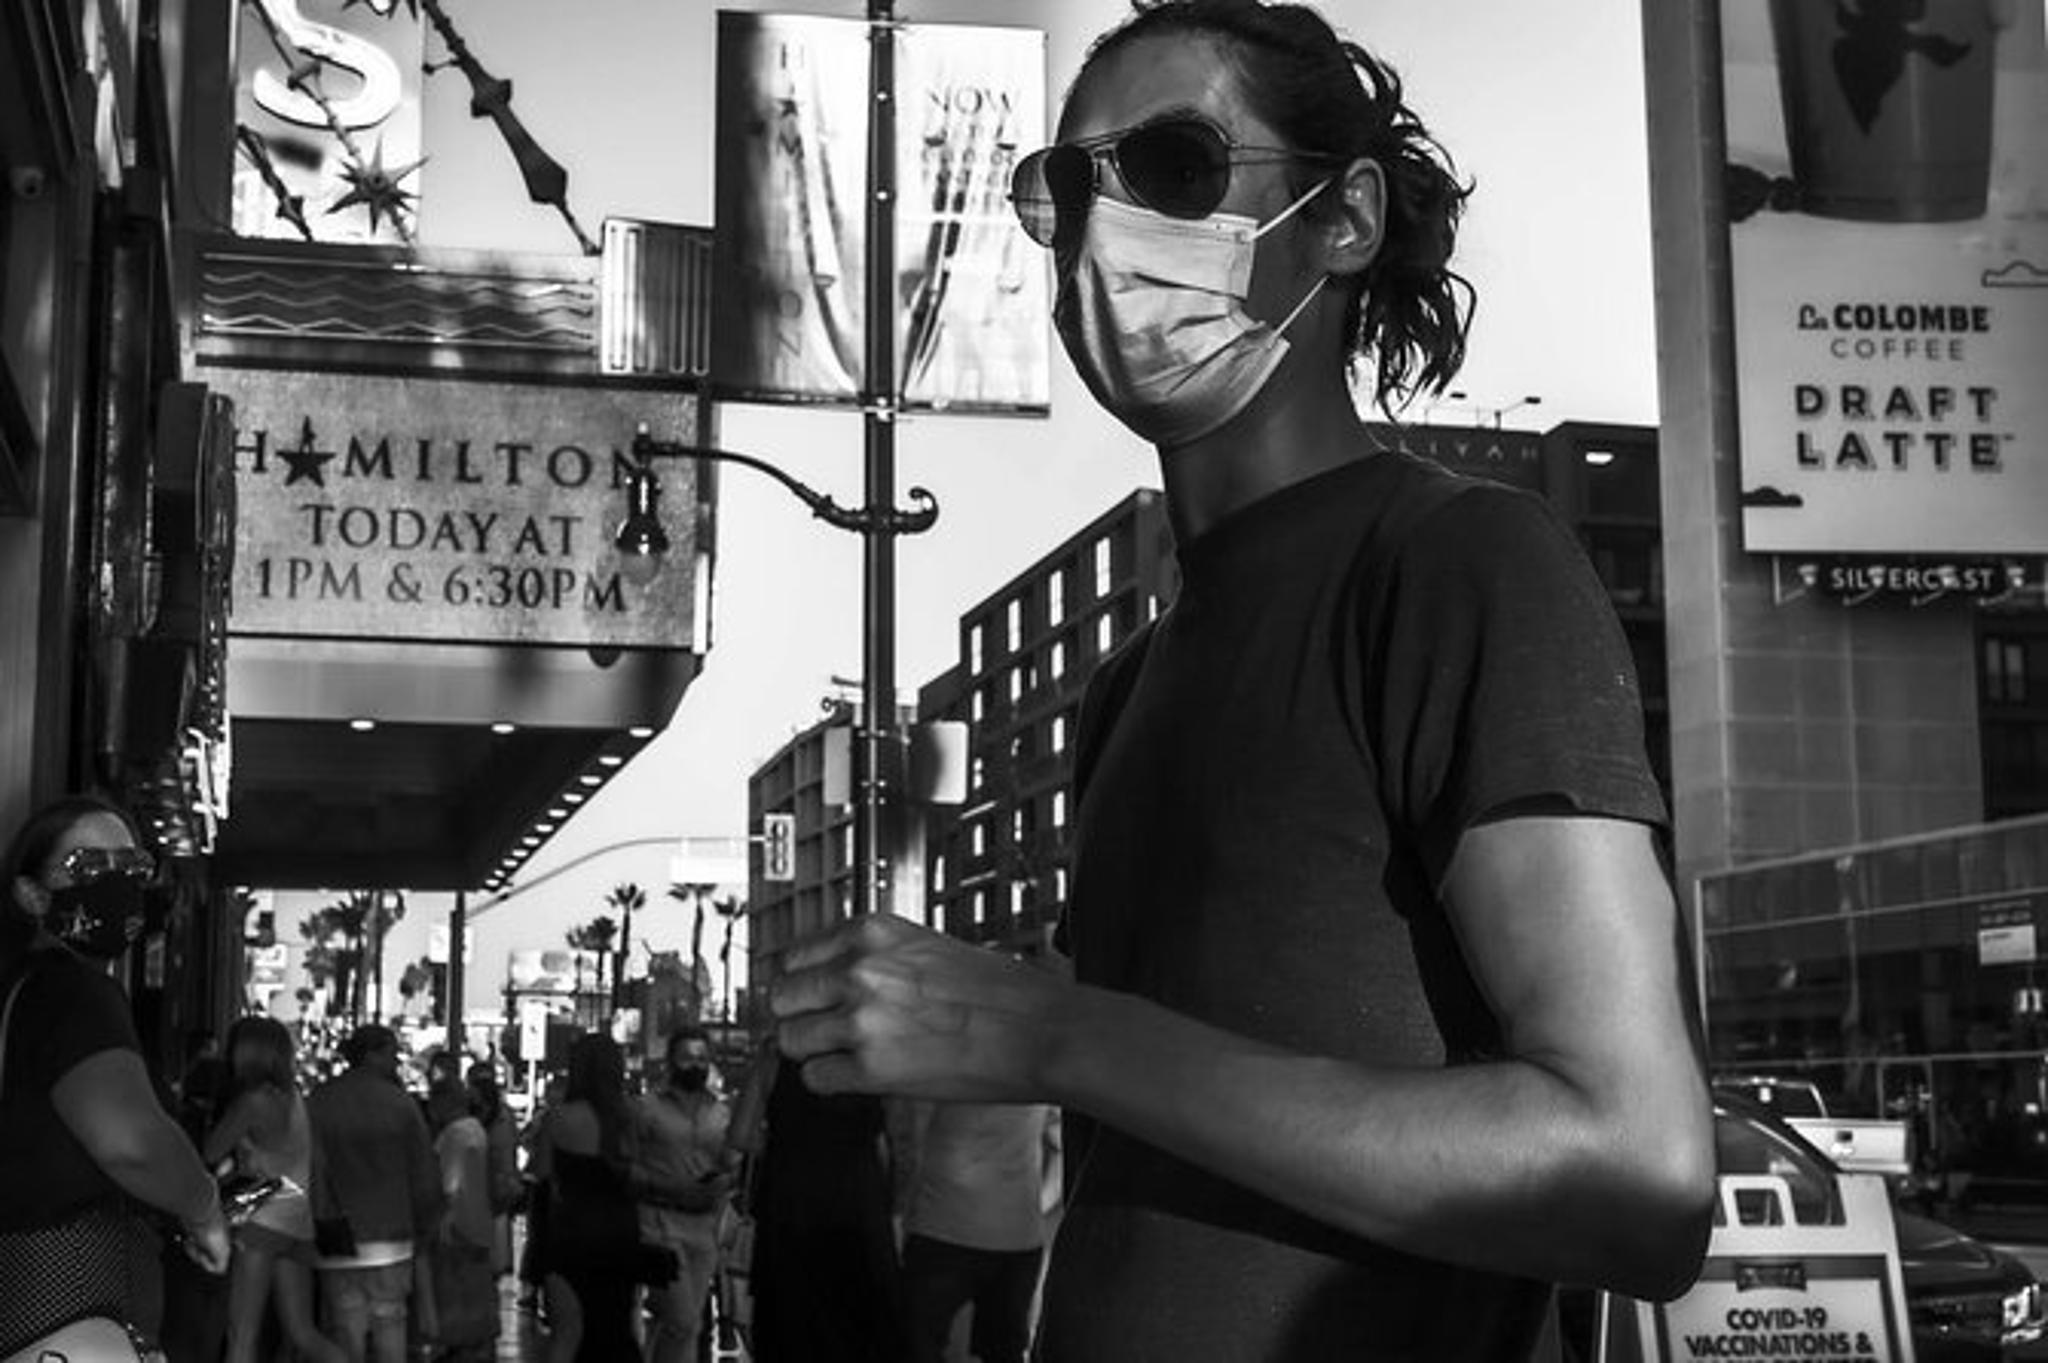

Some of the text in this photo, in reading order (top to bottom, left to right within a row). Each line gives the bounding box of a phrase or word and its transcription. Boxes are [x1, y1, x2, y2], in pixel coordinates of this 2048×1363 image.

[1797, 304, 1990, 333] La COLOMBE
[1830, 338, 1965, 361] COFFEE
[1795, 384, 1998, 423] DRAFT
[300, 504, 582, 556] TODAY AT
[256, 557, 627, 612] 1PM & 6:30PM
[1831, 566, 1993, 589] SILERCST
[1726, 1307, 1827, 1331] COVID-19
[1685, 1332, 1874, 1357] VACCINATIONS &
